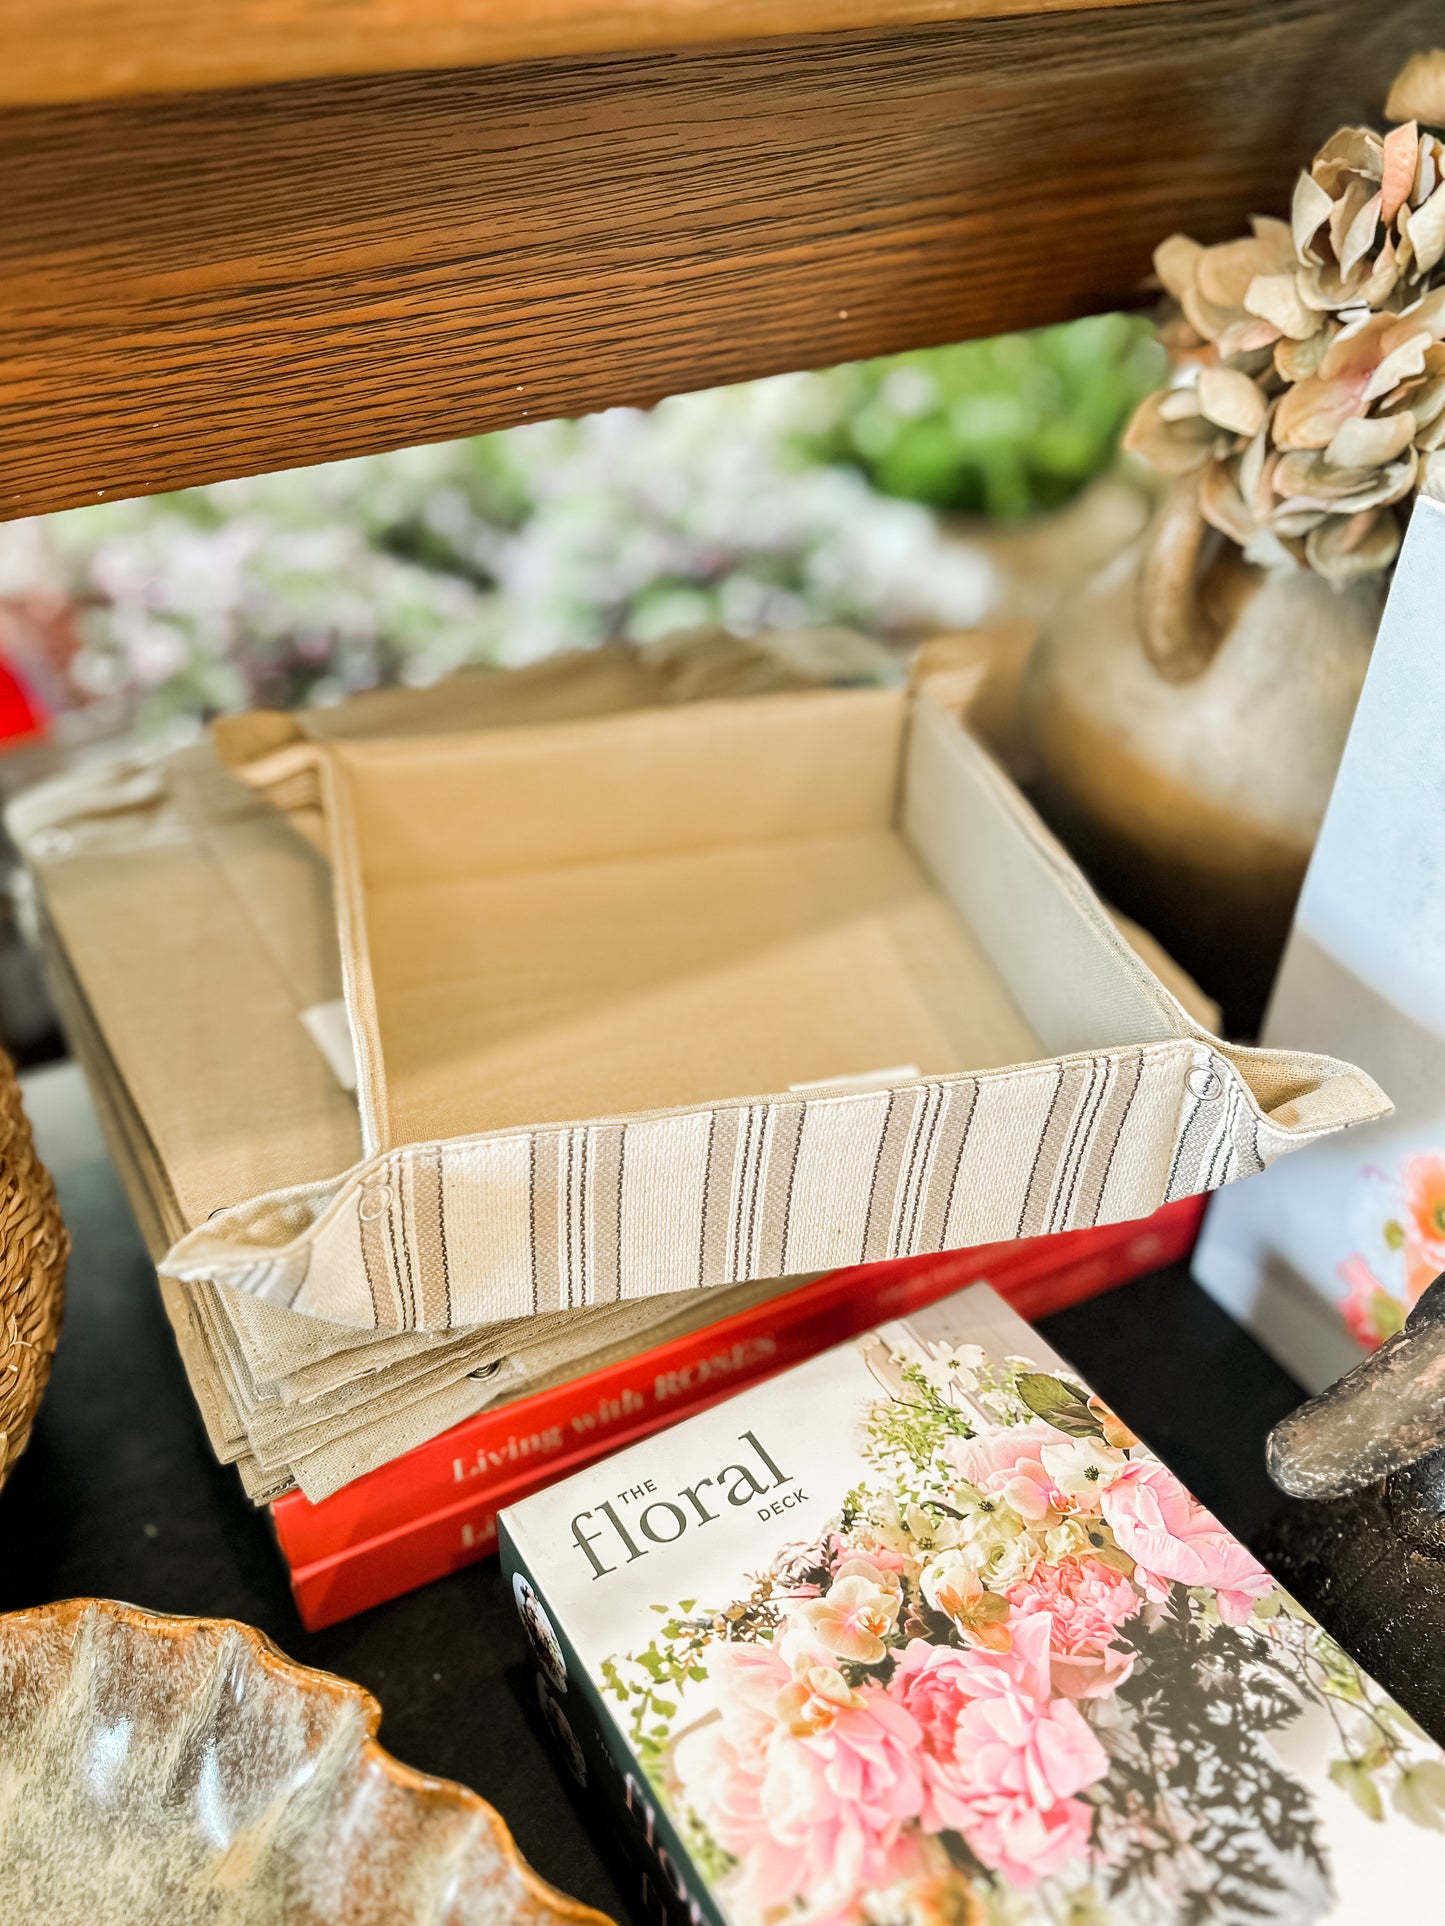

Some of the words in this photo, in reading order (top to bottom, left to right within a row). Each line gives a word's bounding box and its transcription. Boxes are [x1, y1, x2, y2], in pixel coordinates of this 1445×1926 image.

[452, 1424, 564, 1482] Living
[570, 1388, 642, 1433] with
[570, 1430, 794, 1581] floral
[617, 1479, 658, 1505] THE
[757, 1488, 810, 1522] DECK
